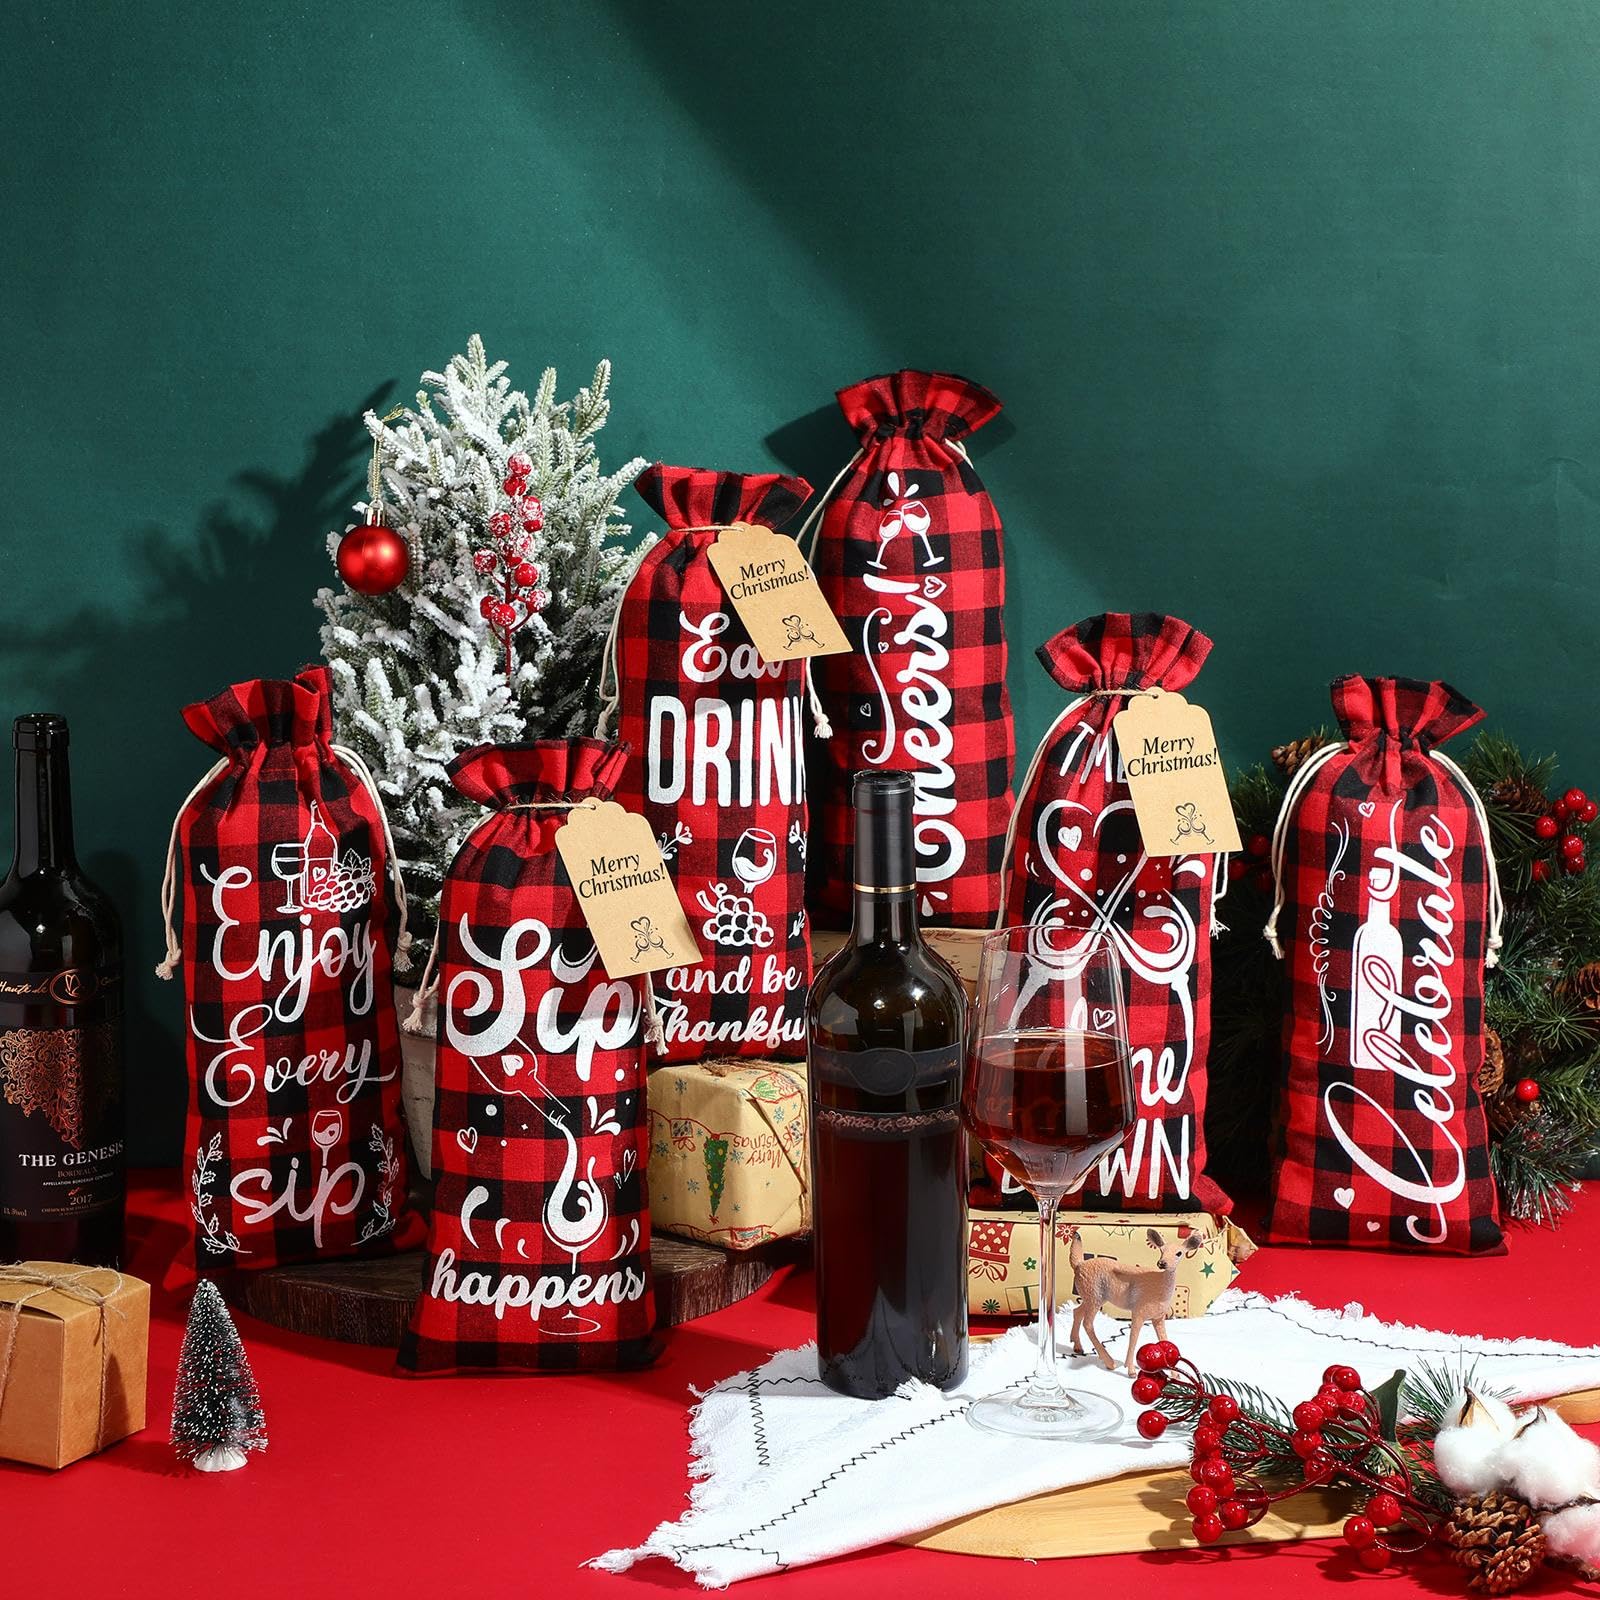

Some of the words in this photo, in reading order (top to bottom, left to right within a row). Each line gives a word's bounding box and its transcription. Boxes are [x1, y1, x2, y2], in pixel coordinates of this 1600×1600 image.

[729, 565, 809, 600] Christmas!
[739, 559, 787, 581] Merry
[1127, 747, 1217, 777] Christmas!
[1143, 736, 1195, 756] Merry
[579, 862, 666, 898] Christmas!
[590, 854, 640, 877] Merry
[200, 863, 376, 1023] Enjoy
[666, 955, 752, 995] and
[763, 953, 802, 994] be
[446, 912, 644, 1082] Sip
[646, 995, 806, 1049] Thankfu
[1324, 799, 1466, 1243] Celebrate
[190, 1003, 397, 1107] Every
[18, 1153, 57, 1167] THE
[62, 1139, 124, 1166] GENESIS
[732, 1133, 777, 1150] istmas
[745, 1149, 783, 1169] Merry
[69, 1193, 94, 1206] 2017
[230, 1157, 365, 1248] sip
[431, 1247, 647, 1323] happens
